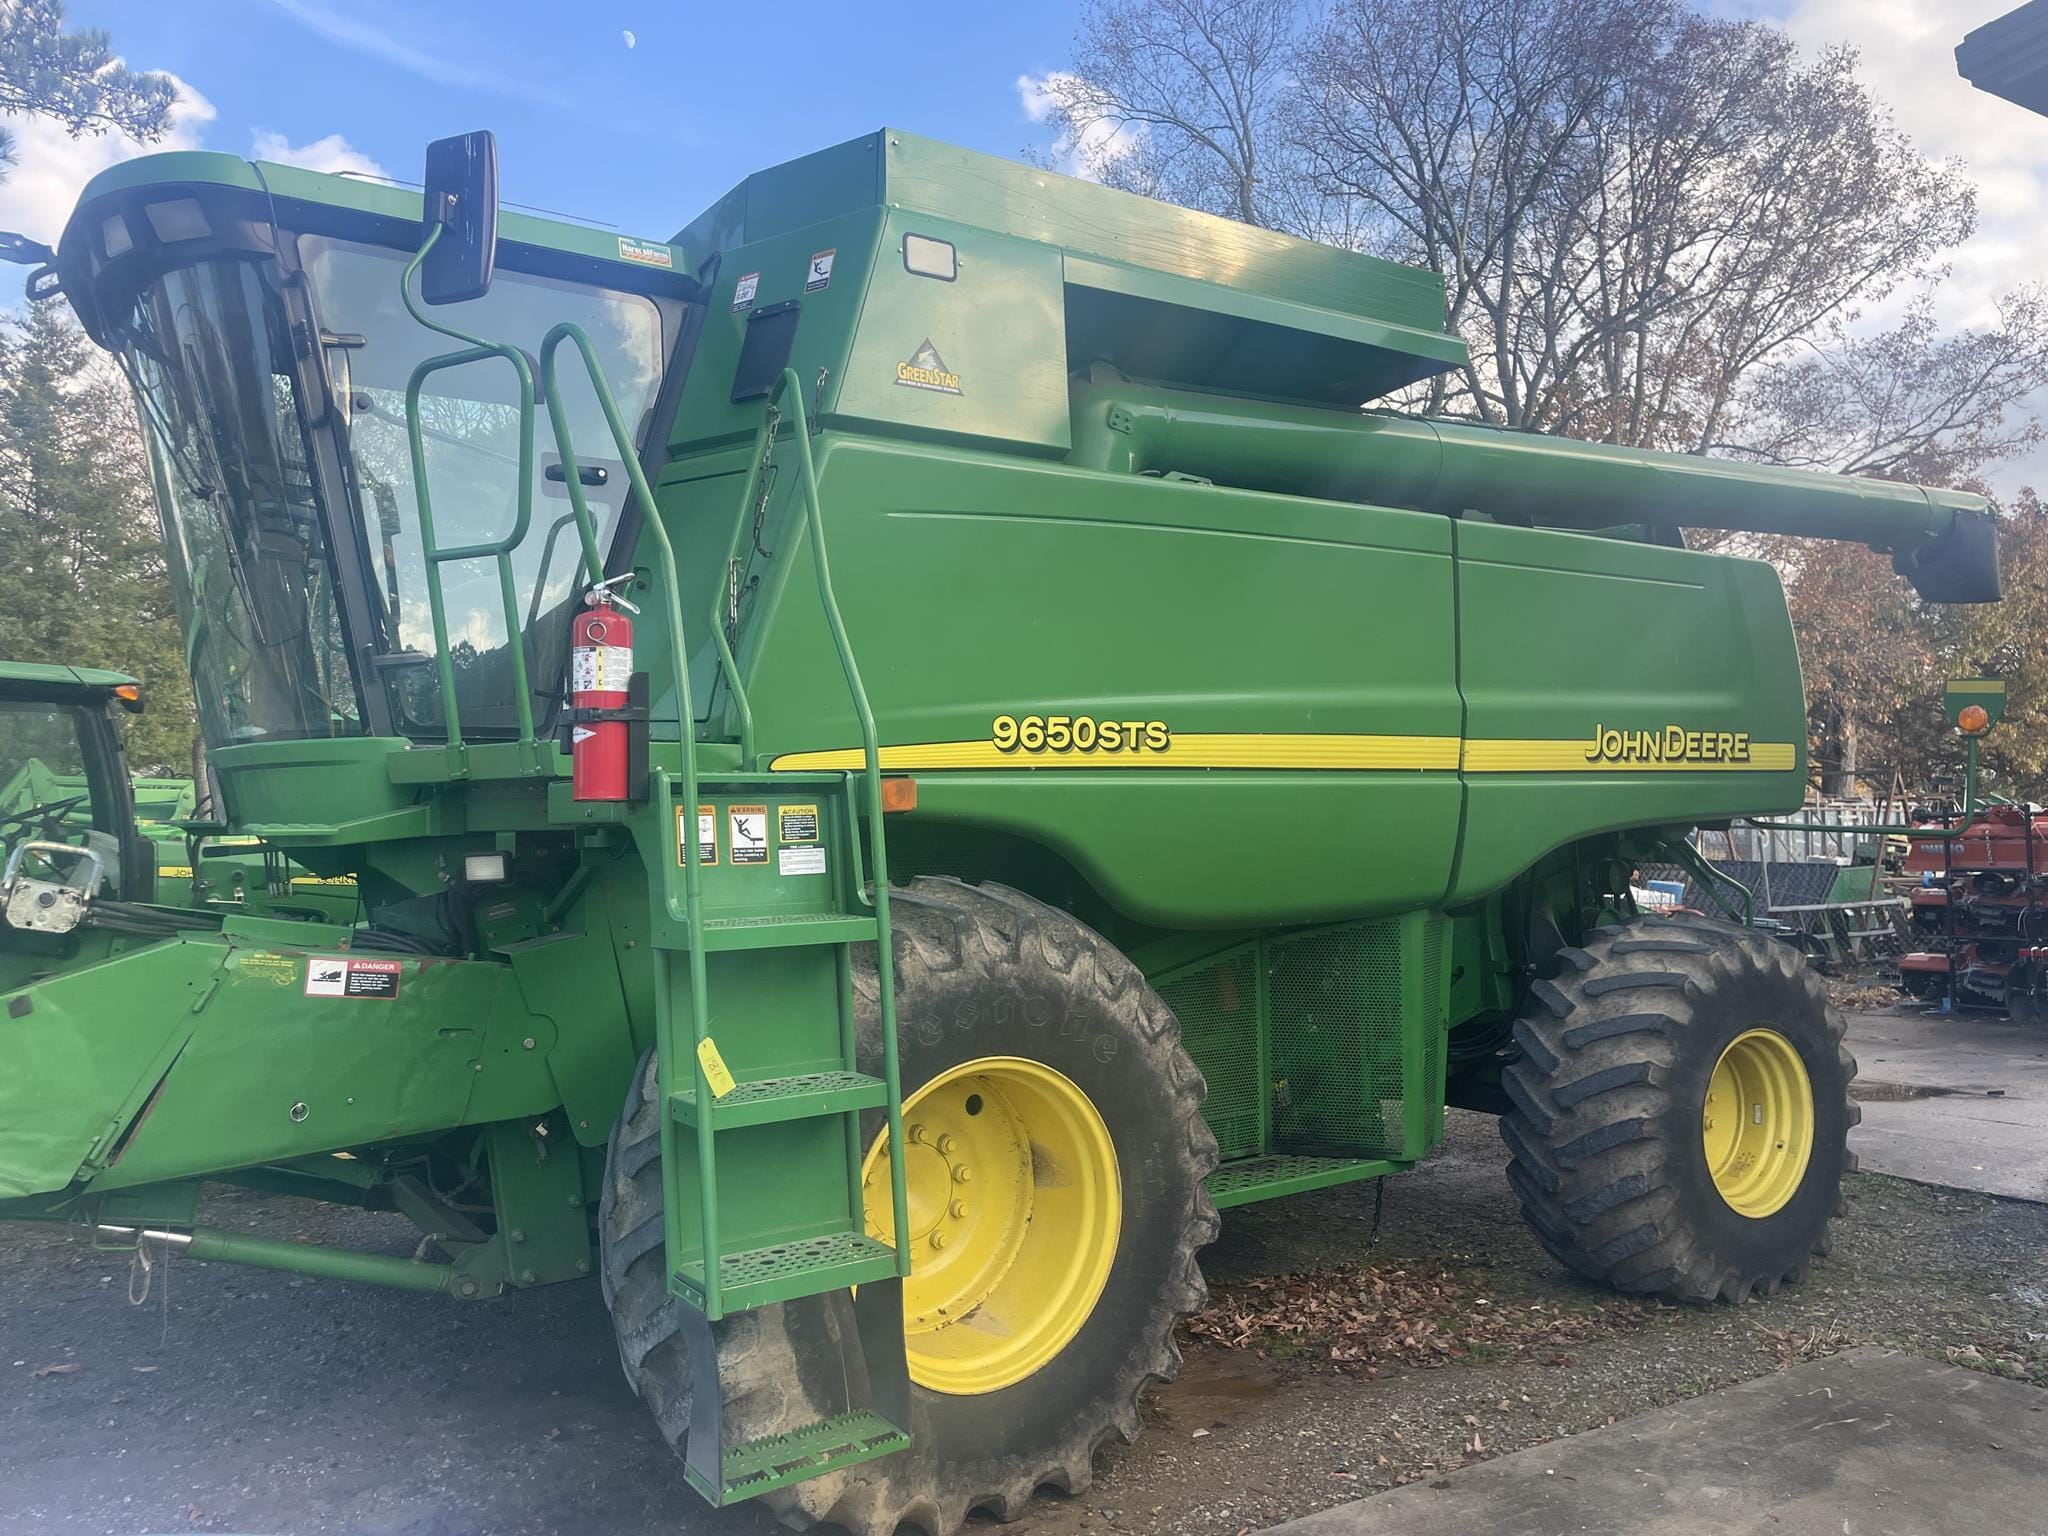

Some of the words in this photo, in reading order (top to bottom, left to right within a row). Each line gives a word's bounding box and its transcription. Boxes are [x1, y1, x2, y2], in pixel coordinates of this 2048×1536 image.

[991, 714, 1171, 754] 9650STS
[1584, 722, 1662, 763] JOHN
[1665, 723, 1751, 763] DEERE
[173, 868, 193, 877] JOH
[361, 962, 395, 971] DANGER
